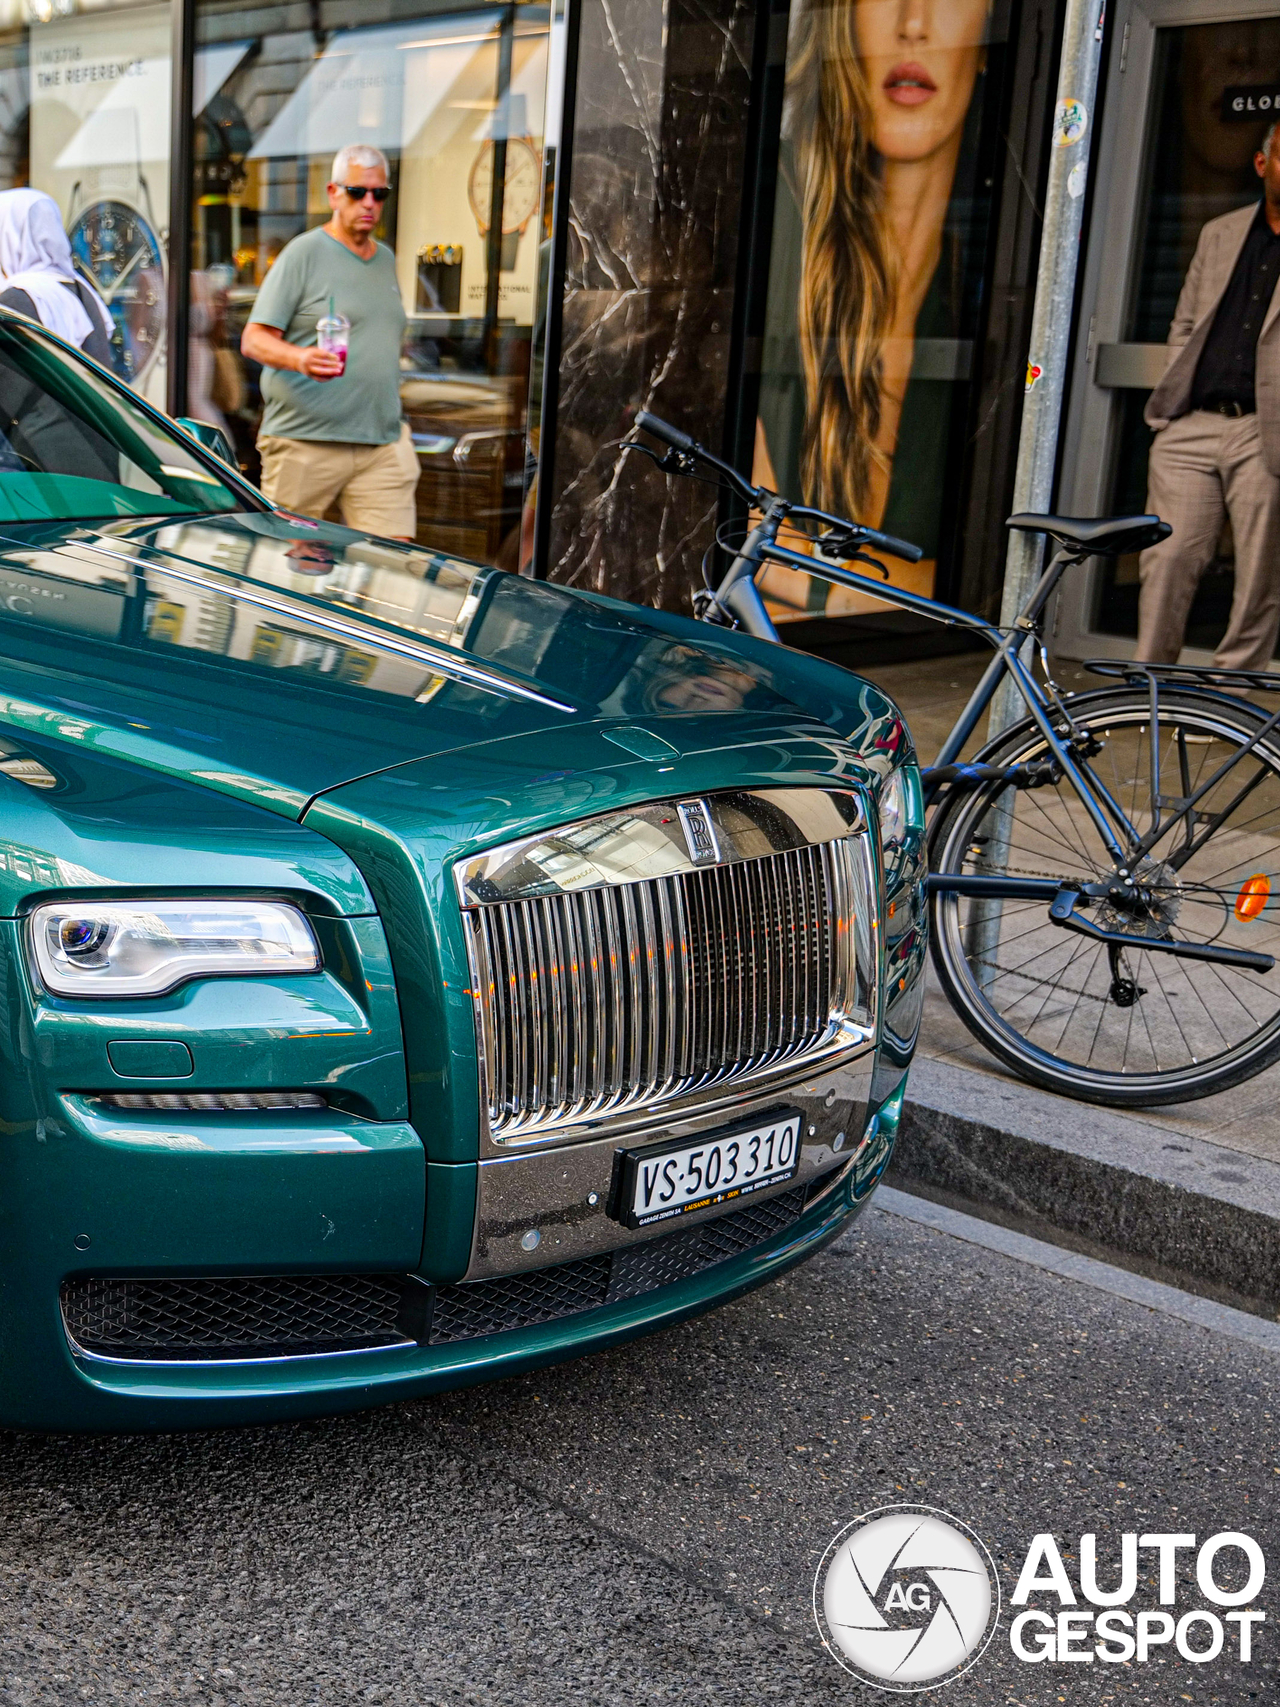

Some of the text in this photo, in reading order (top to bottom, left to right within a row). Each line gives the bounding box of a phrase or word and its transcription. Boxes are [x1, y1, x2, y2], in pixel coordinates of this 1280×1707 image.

[38, 70, 61, 88] THE
[638, 1213, 660, 1226] GARAGE
[684, 1198, 711, 1212] LAUSANNE
[726, 1189, 740, 1199] SION
